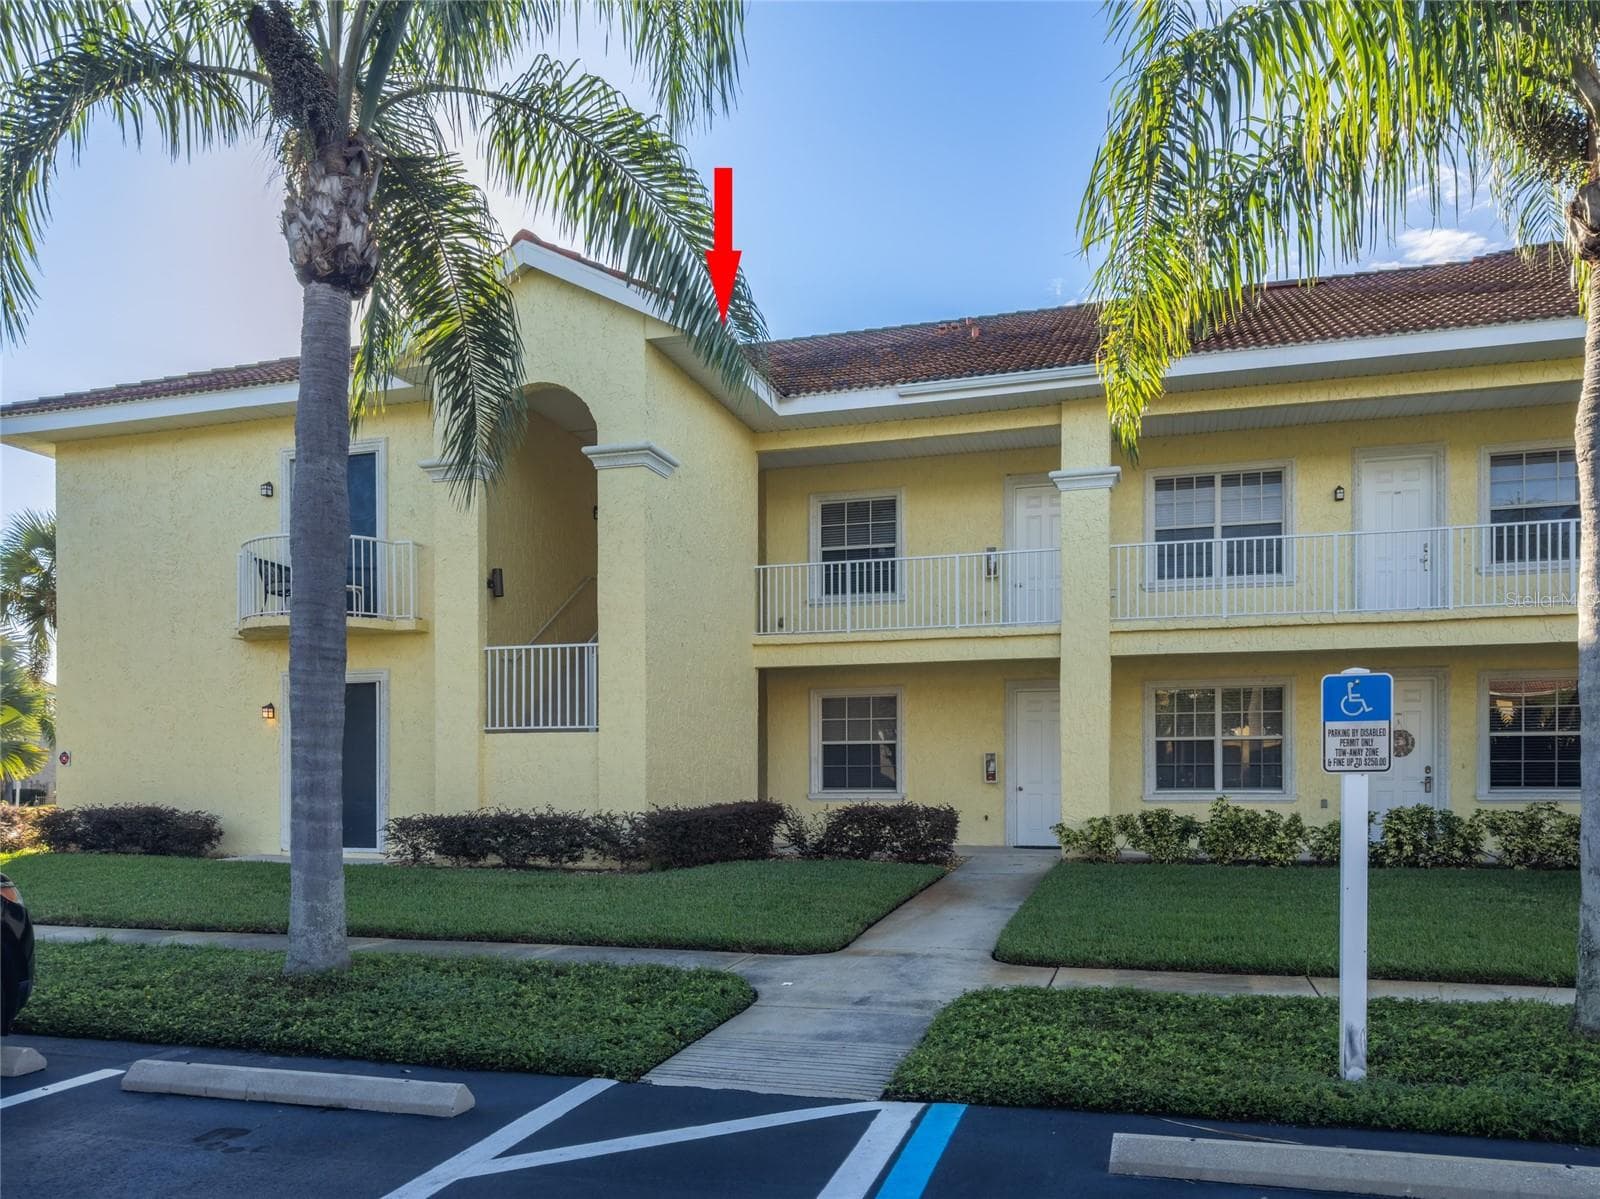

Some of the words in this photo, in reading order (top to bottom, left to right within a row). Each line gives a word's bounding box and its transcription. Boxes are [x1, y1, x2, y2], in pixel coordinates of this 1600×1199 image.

[1327, 728, 1350, 737] PARKING
[1351, 728, 1359, 737] BY
[1360, 728, 1386, 737] DISABLED
[1340, 738, 1359, 747] PERMIT
[1361, 738, 1373, 747] ONLY
[1335, 748, 1363, 757] TOW-AWAY
[1365, 748, 1379, 757] ZONE
[1327, 758, 1332, 767] &
[1333, 758, 1345, 767] FINE
[1346, 758, 1354, 767] UP
[1355, 758, 1362, 767] TO
[1364, 757, 1386, 766] $250.00
